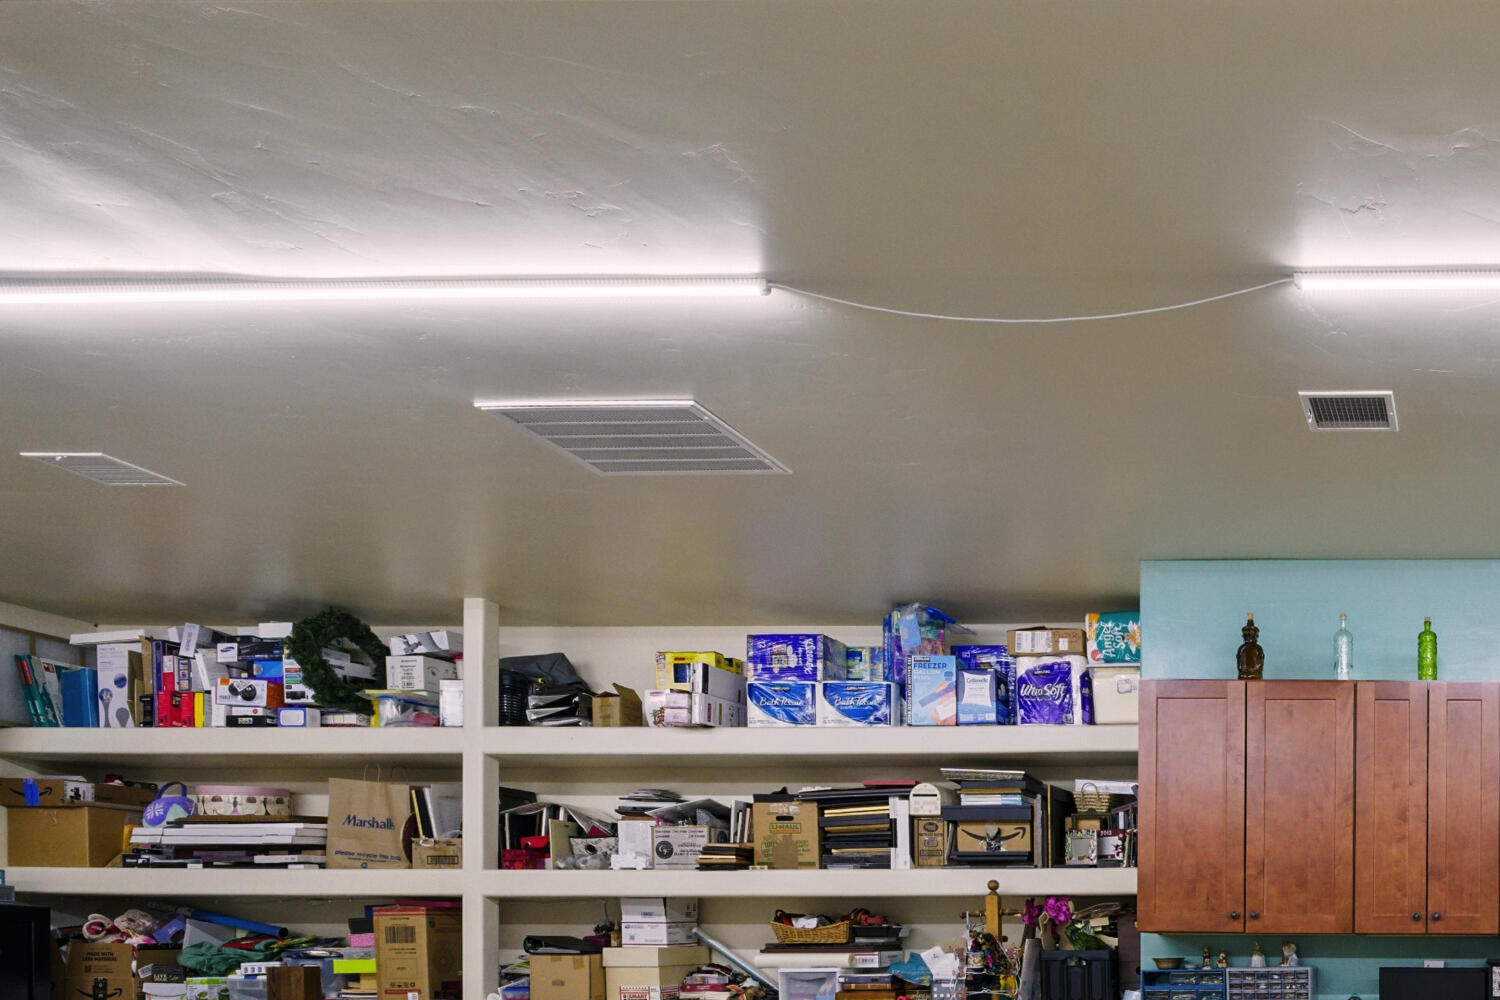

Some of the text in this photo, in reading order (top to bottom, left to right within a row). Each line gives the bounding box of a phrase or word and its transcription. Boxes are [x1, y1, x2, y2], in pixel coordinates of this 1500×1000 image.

[1101, 621, 1126, 658] Angel Soft
[1044, 684, 1066, 702] Soft
